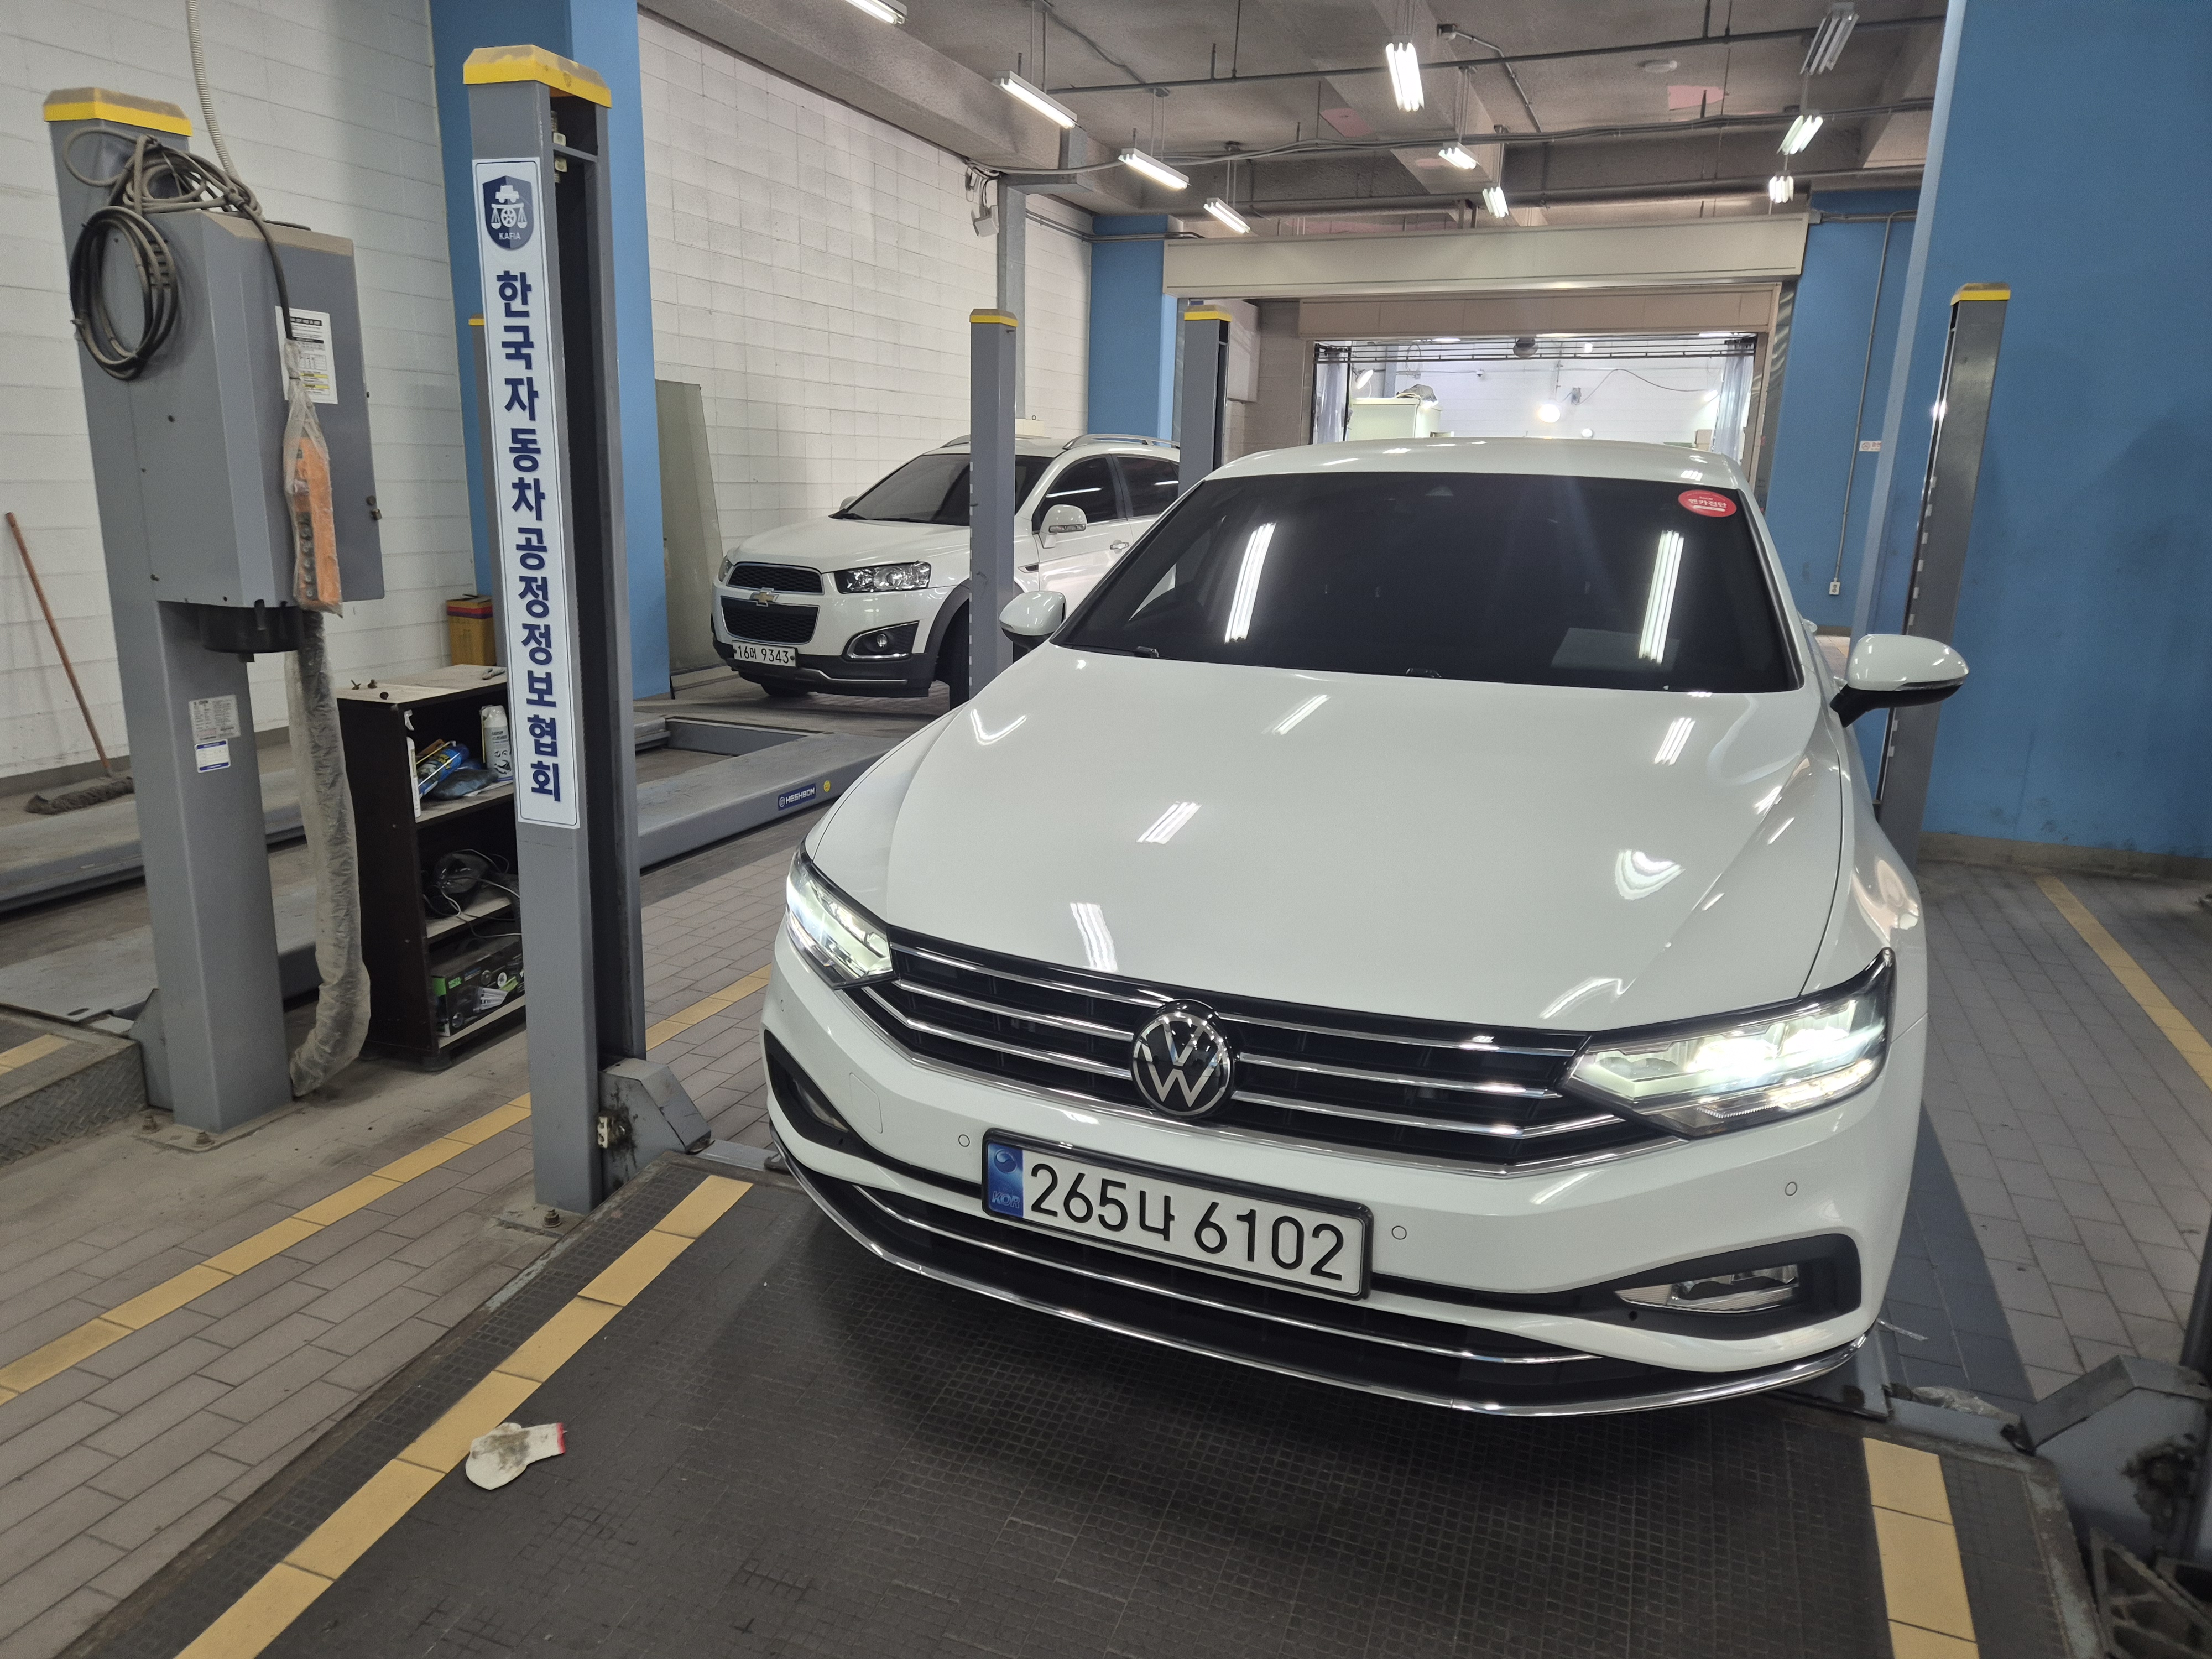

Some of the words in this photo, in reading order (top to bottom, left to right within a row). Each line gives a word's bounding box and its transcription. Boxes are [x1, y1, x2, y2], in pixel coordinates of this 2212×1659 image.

[497, 270, 561, 802] 한국자동차공정정보협회
[738, 645, 757, 660] 16머
[761, 648, 790, 664] 9343
[785, 787, 815, 804] HESHBON
[992, 1191, 1020, 1209] KOR
[1030, 1162, 1176, 1243] 265나
[1194, 1201, 1344, 1282] 6102
